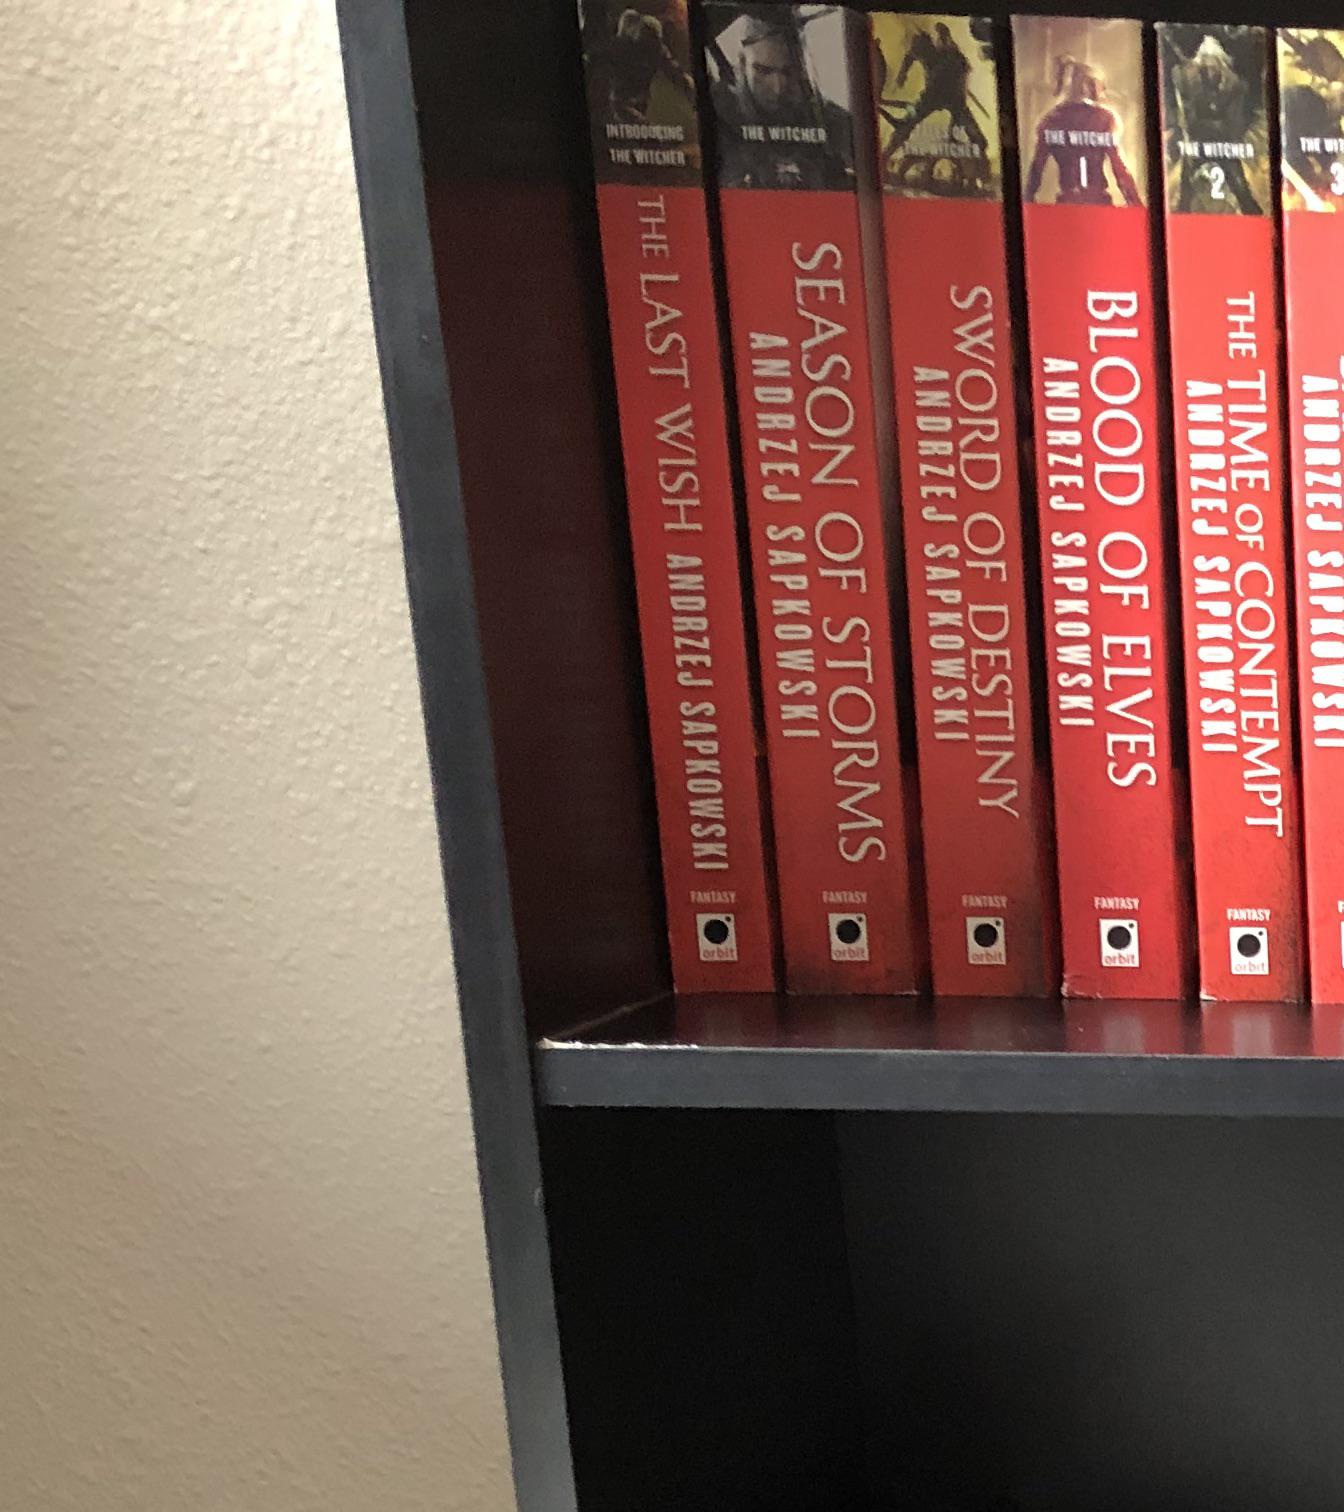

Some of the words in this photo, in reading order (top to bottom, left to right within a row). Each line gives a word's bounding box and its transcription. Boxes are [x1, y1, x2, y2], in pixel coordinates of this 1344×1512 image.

[606, 124, 684, 142] INTRODUCING
[741, 126, 765, 142] THE
[768, 126, 828, 143] WITCHER
[1210, 165, 1226, 199] 2
[637, 194, 670, 260] THE
[639, 272, 690, 390] LAST
[791, 241, 860, 489] SEASON
[950, 284, 1002, 493] SWORD
[1226, 291, 1256, 360] THE
[749, 332, 802, 503] ANDRZEJ
[1086, 289, 1146, 509] BLOOD
[1228, 370, 1271, 494] TIME
[655, 403, 703, 532] WISH
[1234, 503, 1264, 552] OF
[815, 512, 867, 594] OF
[963, 513, 1006, 584] OF
[1098, 537, 1149, 609] OF
[666, 553, 713, 689] ANDRZEJ
[766, 525, 820, 738] SAPKOWSKI
[822, 615, 887, 863] STORMS
[967, 603, 1019, 820] DESTINY
[1100, 633, 1157, 788] ELVES
[1233, 562, 1283, 838] CONTEMPT
[679, 701, 729, 870] SAPKOWSKI
[1095, 896, 1140, 911] FANTASY
